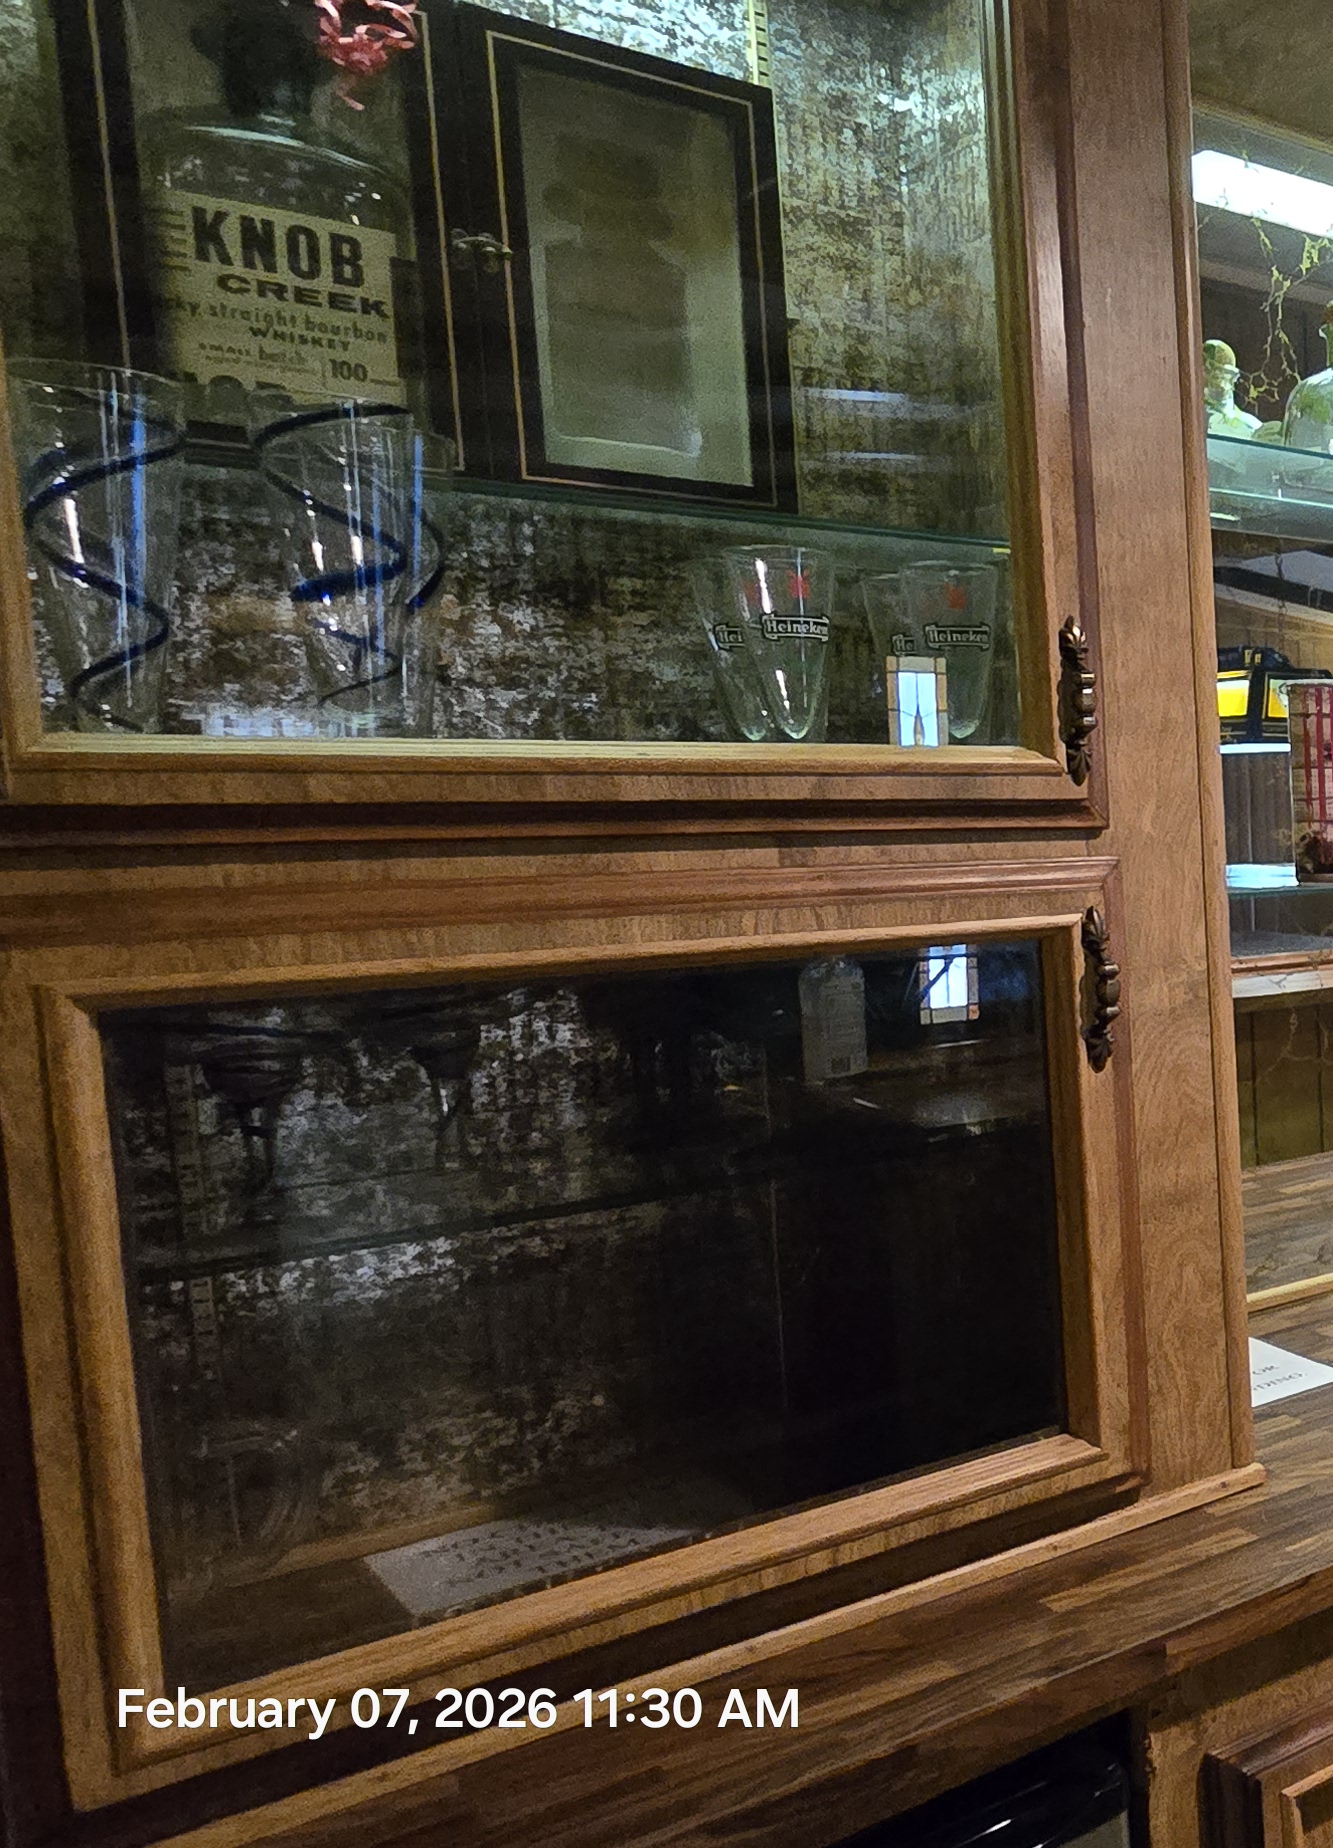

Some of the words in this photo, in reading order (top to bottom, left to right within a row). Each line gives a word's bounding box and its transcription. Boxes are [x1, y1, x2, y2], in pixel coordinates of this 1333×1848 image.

[191, 205, 365, 289] KNOB
[216, 273, 391, 320] CREEK
[328, 357, 369, 383] 100
[766, 620, 830, 636] Heineken
[928, 628, 990, 644] Heineken
